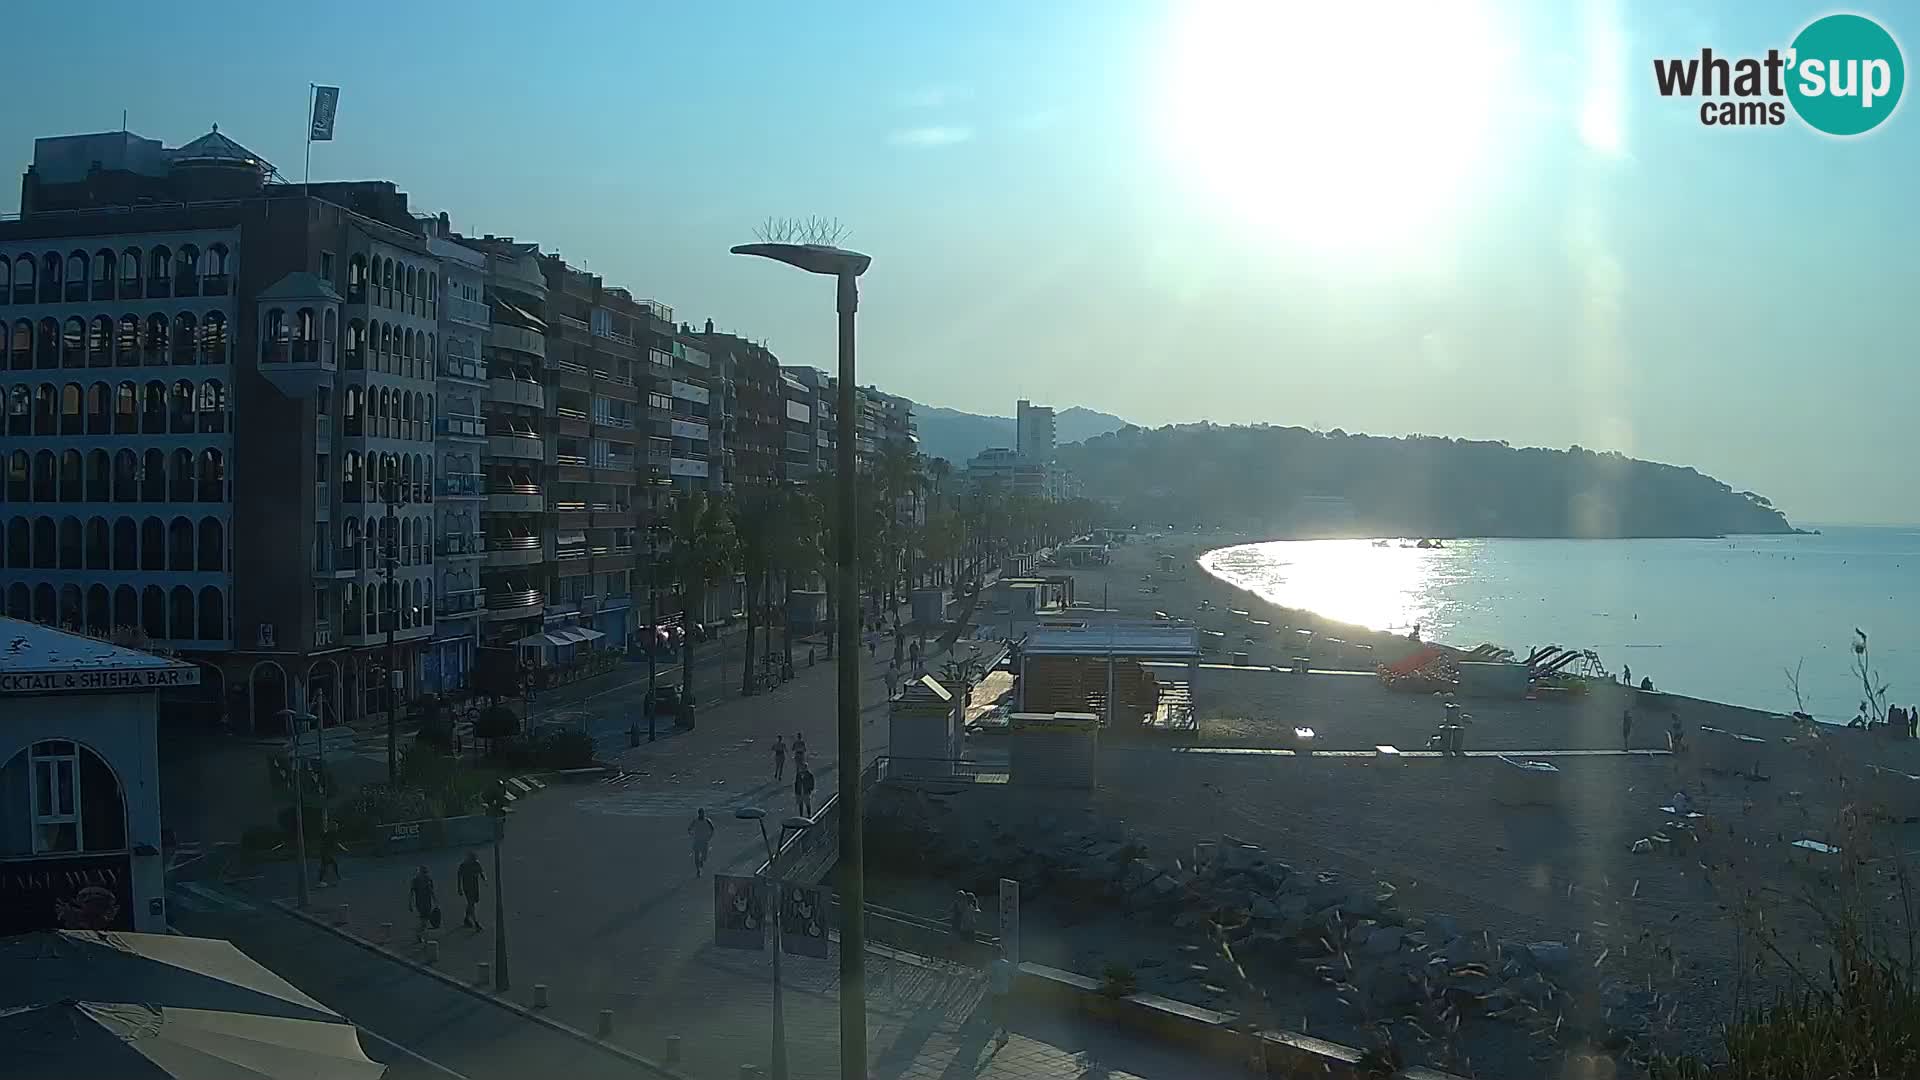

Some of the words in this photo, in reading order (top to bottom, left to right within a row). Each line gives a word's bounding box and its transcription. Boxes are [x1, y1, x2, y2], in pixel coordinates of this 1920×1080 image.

[65, 674, 76, 688] &
[81, 672, 142, 688] SHISHA
[147, 669, 179, 685] BAR
